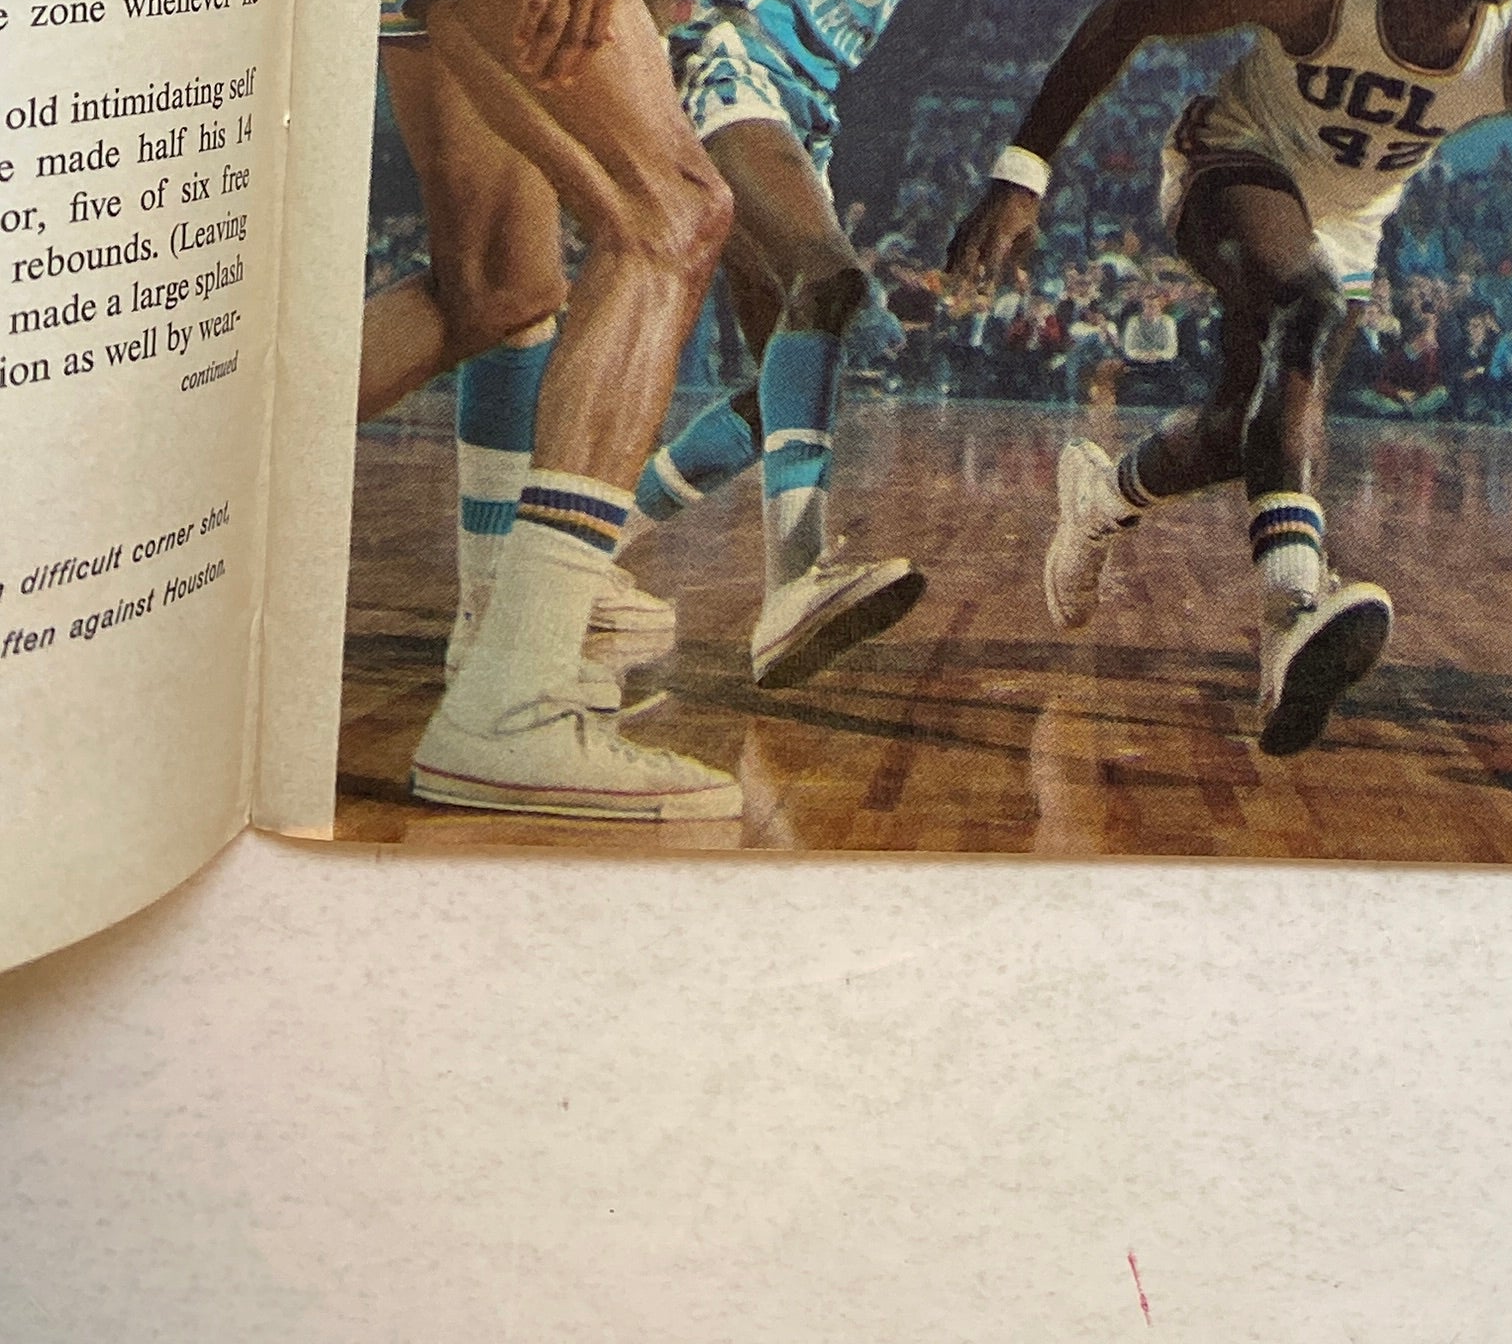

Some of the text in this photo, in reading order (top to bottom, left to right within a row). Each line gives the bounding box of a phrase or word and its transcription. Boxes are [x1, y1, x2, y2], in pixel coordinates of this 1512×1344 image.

[6, 67, 256, 130] old intimidating self
[1296, 62, 1446, 138] UCL
[12, 211, 247, 283] rebounds. (Leaving
[21, 545, 122, 594] difficult
[132, 524, 194, 563] corner
[69, 588, 155, 640] against
